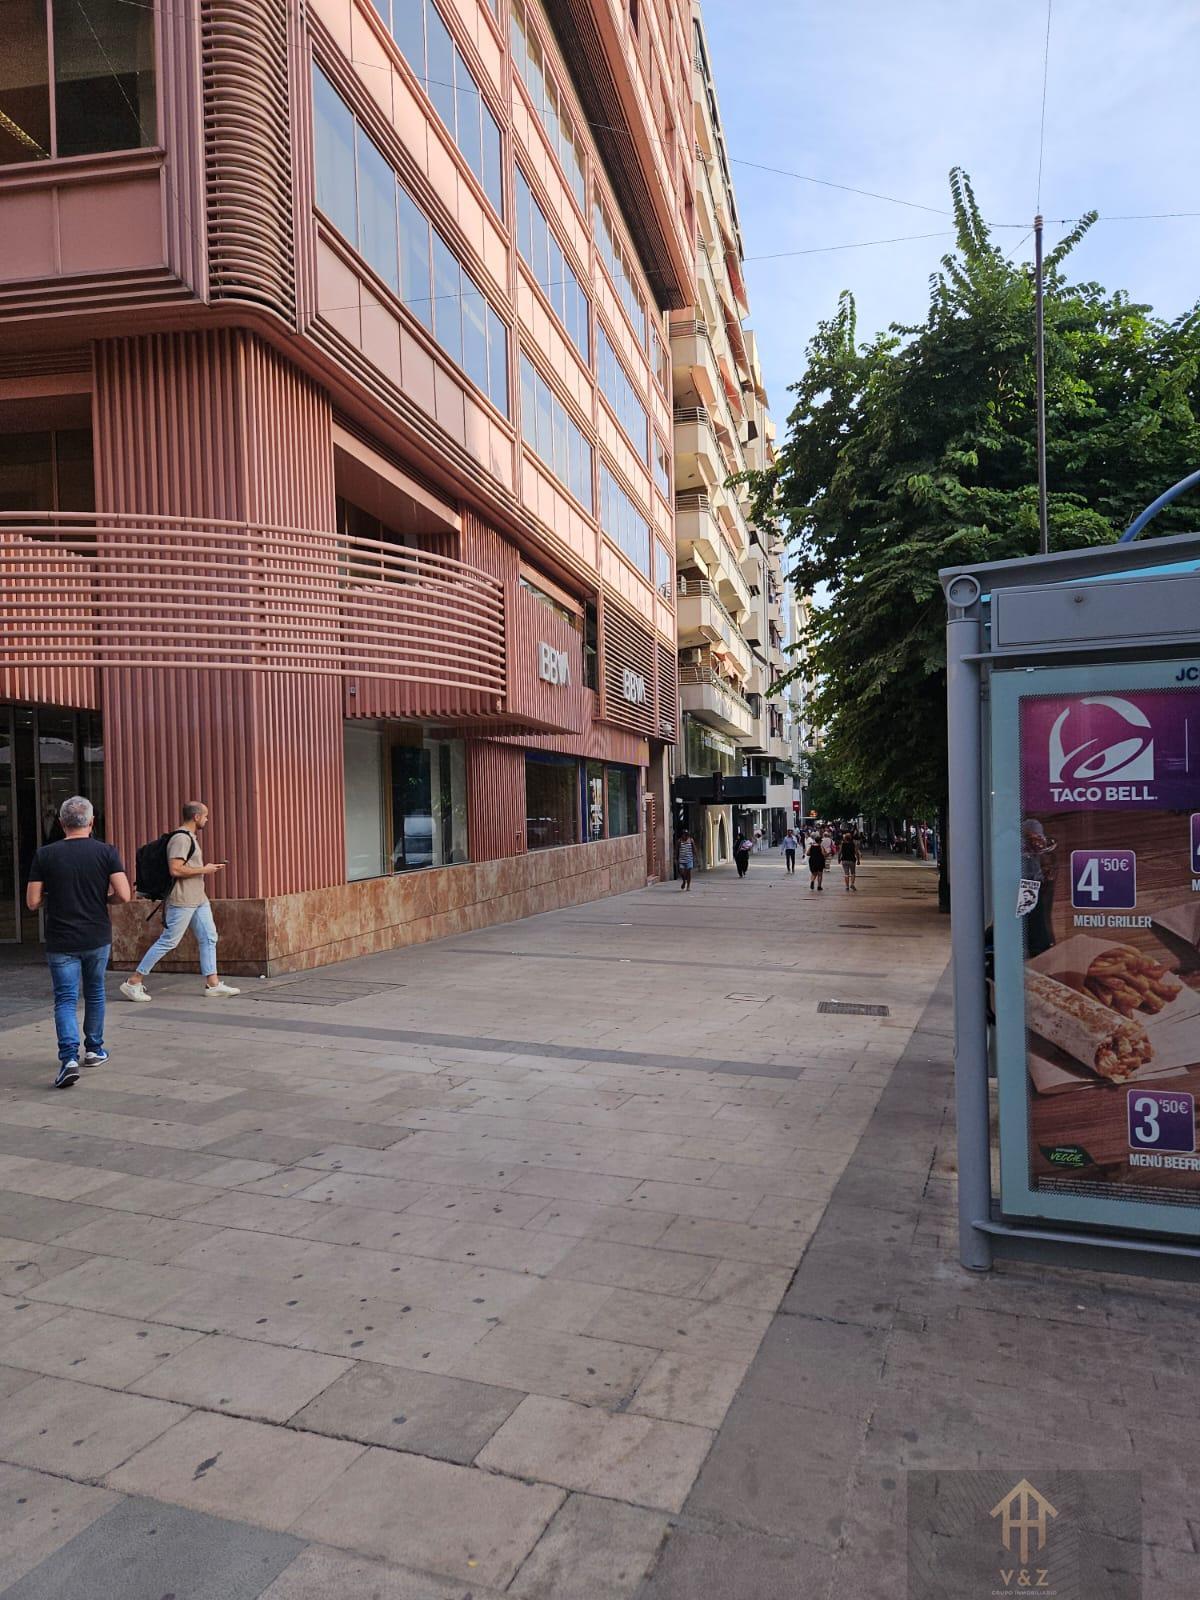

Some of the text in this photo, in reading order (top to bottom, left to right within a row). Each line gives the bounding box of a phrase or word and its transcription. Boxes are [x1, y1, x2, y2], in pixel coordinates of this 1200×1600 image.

[539, 641, 571, 688] BBVA
[623, 668, 646, 704] BBVA
[1050, 787, 1102, 802] TACO
[1073, 913, 1152, 928] MENÚ GRILLER
[1129, 1153, 1162, 1168] MENÚ
